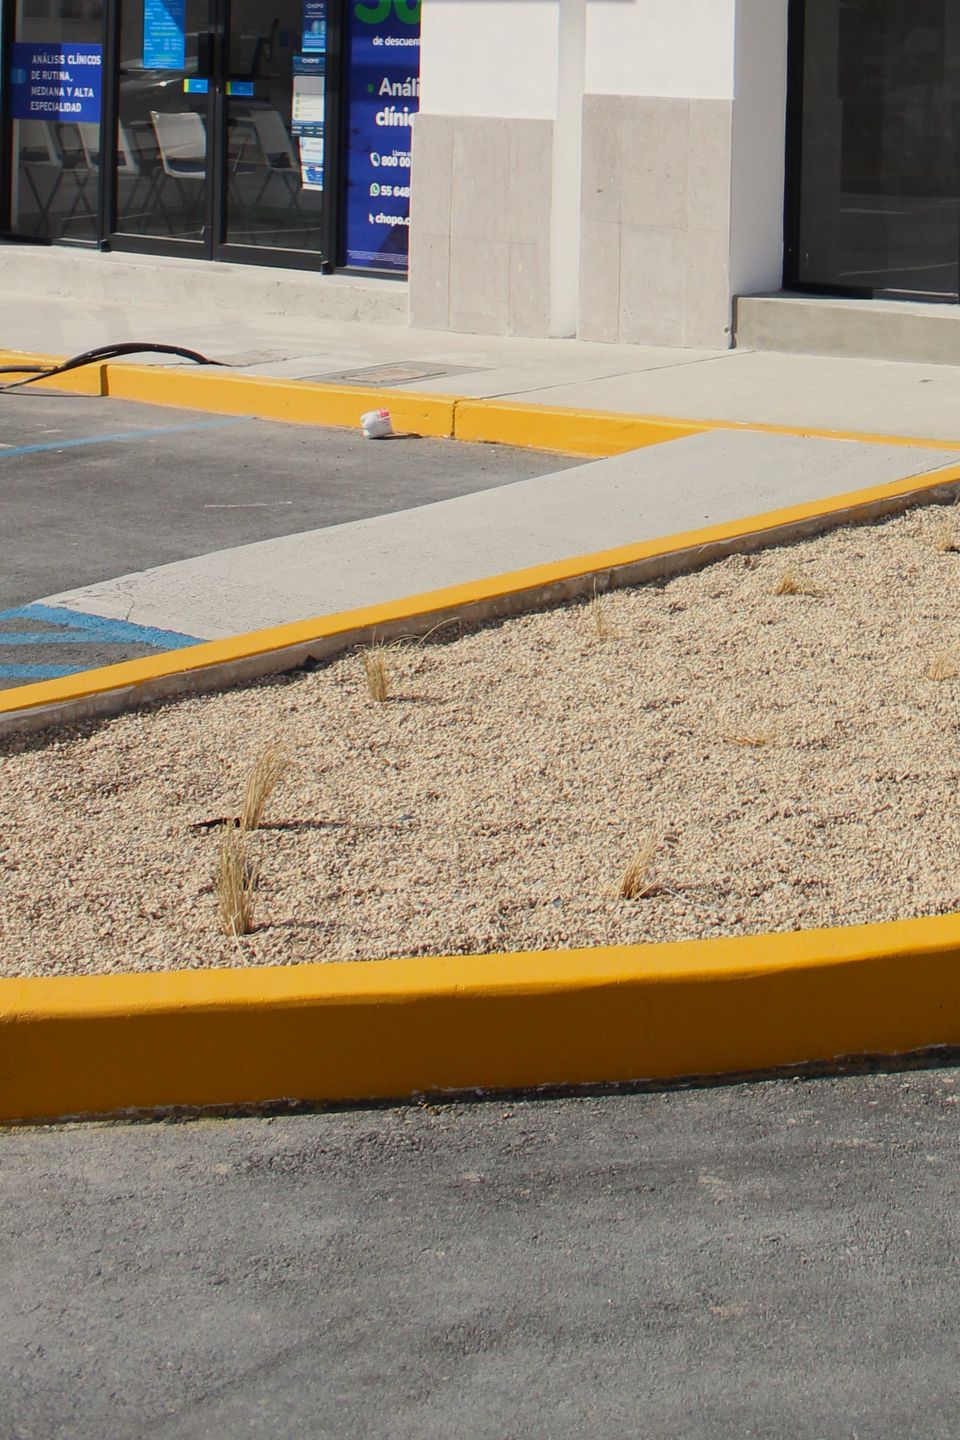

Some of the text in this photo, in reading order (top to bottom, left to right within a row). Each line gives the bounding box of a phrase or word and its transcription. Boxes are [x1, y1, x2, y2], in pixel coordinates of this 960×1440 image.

[372, 36, 383, 46] de
[31, 53, 101, 65] ANÁLISIS CLÍNICOS
[31, 70, 73, 82] DE RUTINA,
[31, 86, 94, 98] MEDIANA Y ALTA
[30, 101, 82, 112] ESPECIALIDAD
[381, 155, 398, 167] 800
[380, 185, 393, 197] 55
